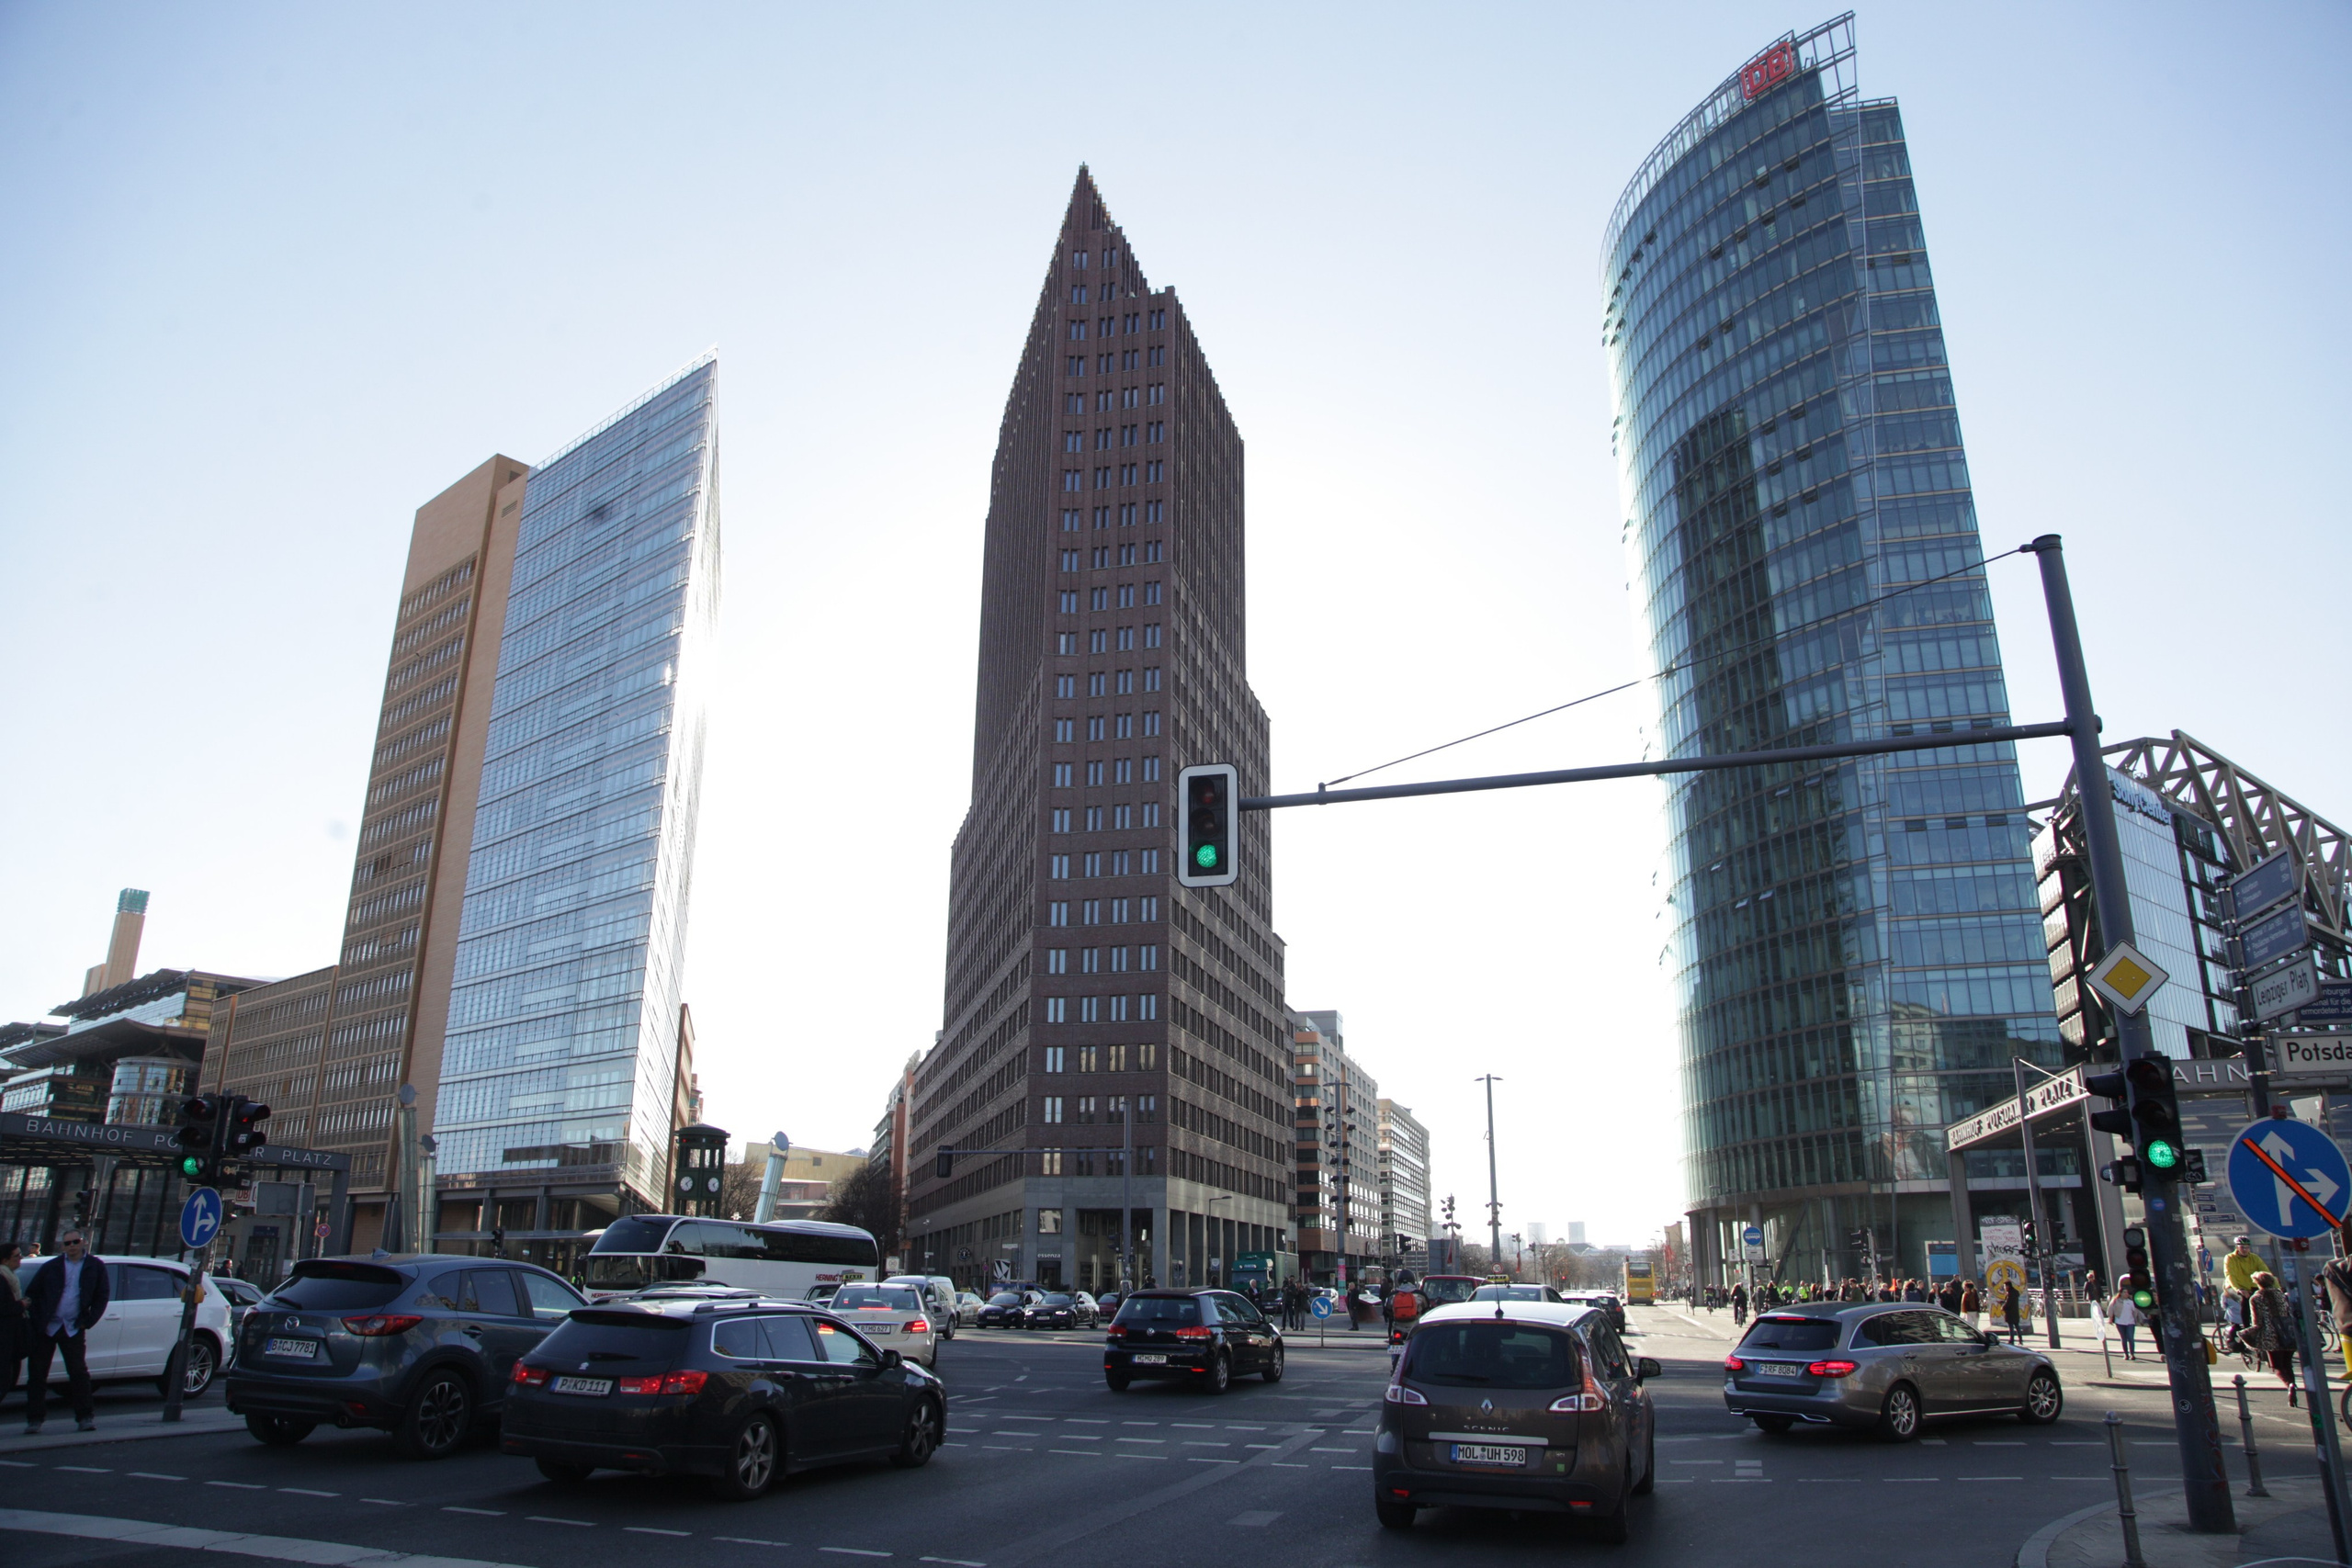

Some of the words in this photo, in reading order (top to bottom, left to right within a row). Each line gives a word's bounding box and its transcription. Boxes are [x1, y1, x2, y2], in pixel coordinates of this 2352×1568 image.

[1747, 51, 1787, 88] DB
[2255, 980, 2289, 1007] Leipziger
[2323, 987, 2352, 997] nburger
[2340, 998, 2352, 1006] die
[1951, 1119, 1984, 1145] BAHNHOF
[2039, 1077, 2075, 1108] PLATZ
[26, 1119, 134, 1143] BAHNHOF
[282, 1149, 332, 1166] PLATZ
[815, 1273, 838, 1282] HERNING
[294, 1341, 315, 1354] 7781
[1457, 1446, 1478, 1460] MOL
[1487, 1449, 1501, 1461] UH
[1503, 1450, 1524, 1462] 598
